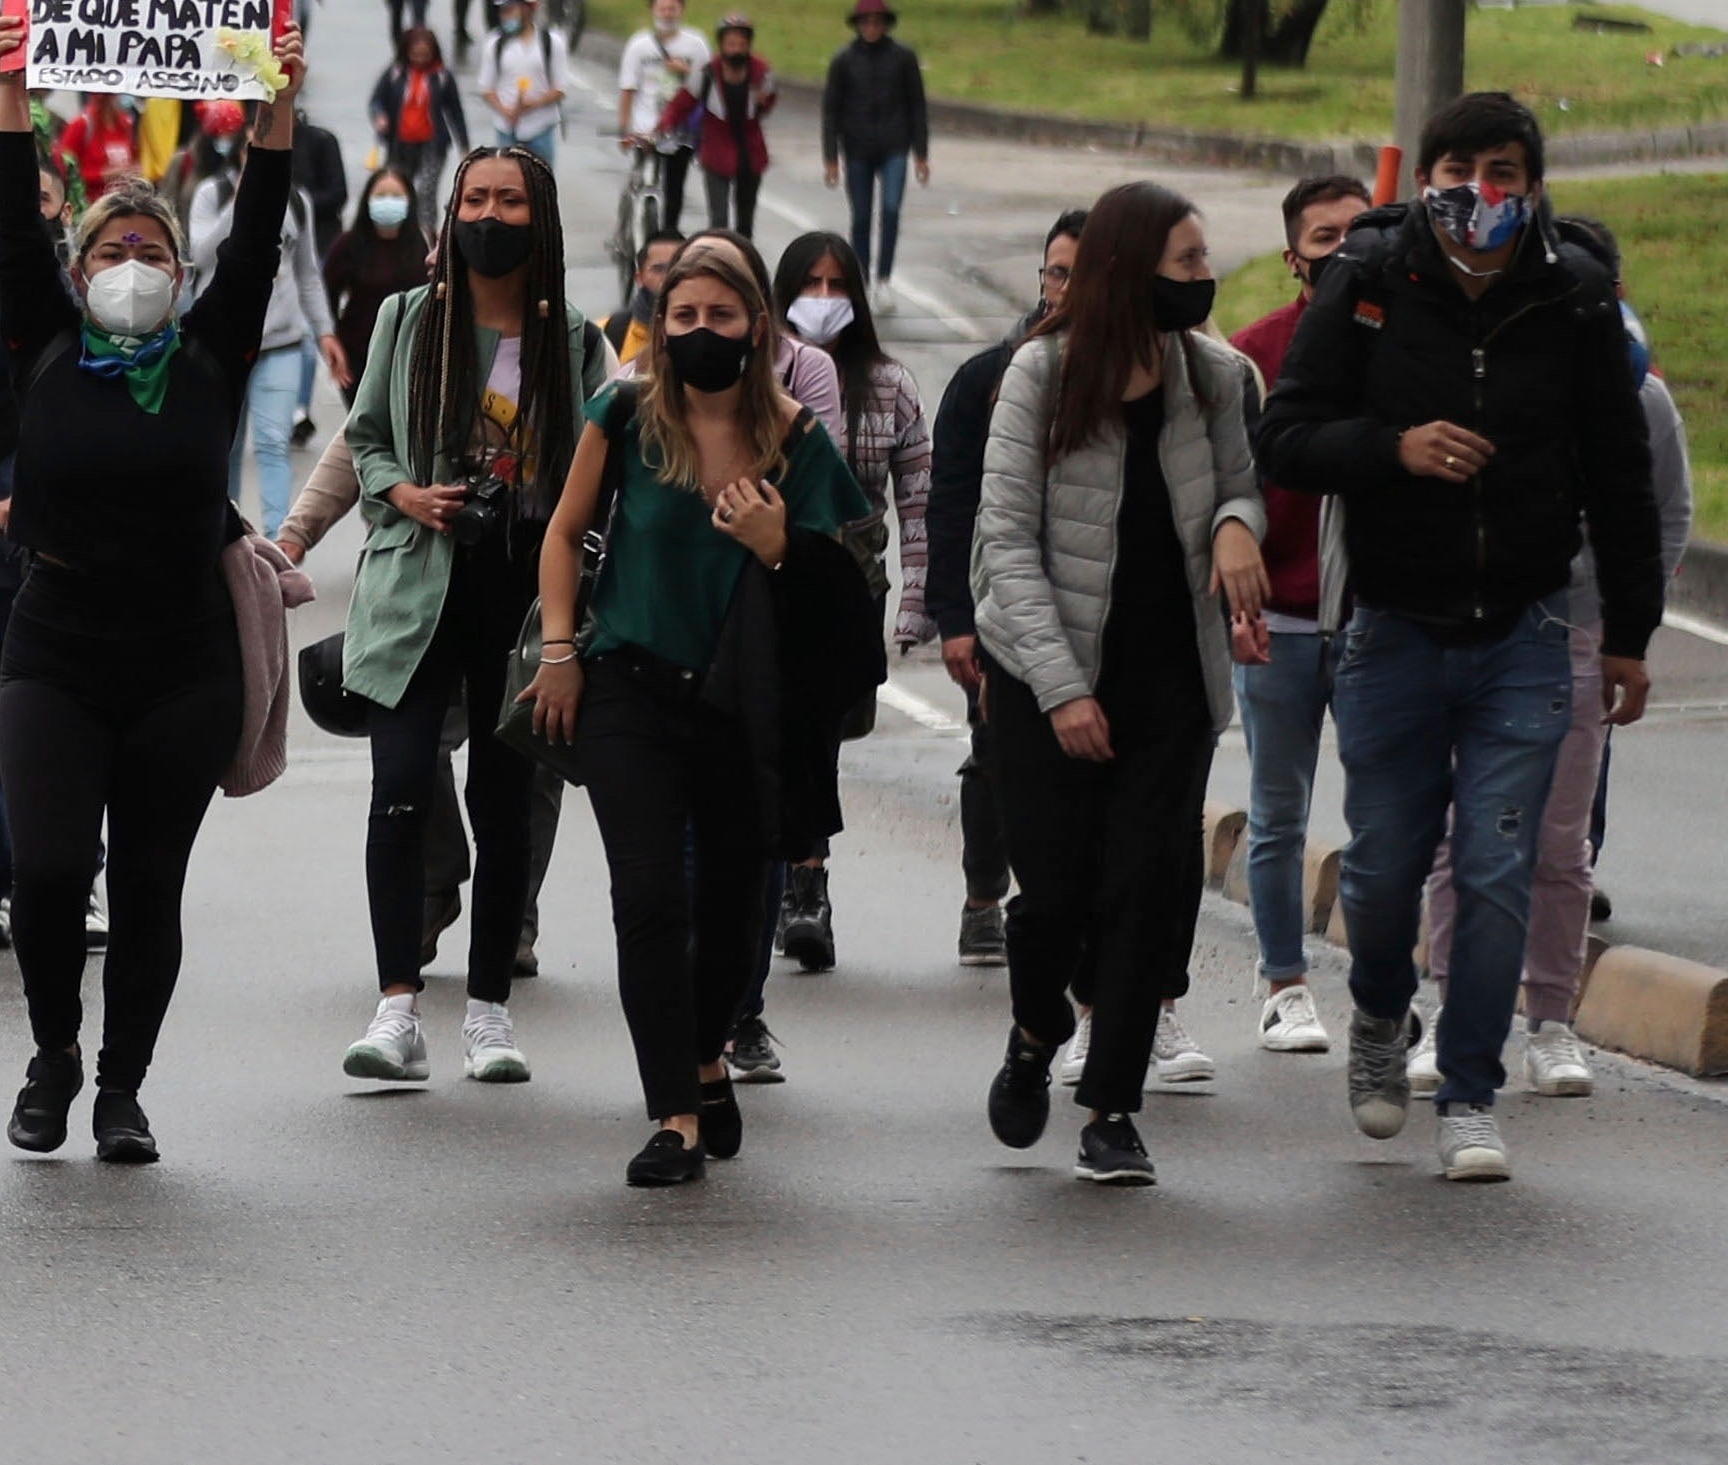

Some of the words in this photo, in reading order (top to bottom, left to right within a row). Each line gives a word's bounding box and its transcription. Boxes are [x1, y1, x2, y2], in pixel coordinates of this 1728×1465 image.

[32, 27, 60, 65] A
[65, 27, 107, 66] MI
[117, 30, 202, 70] PAPÁ
[38, 68, 124, 87] ESTADO
[135, 70, 241, 94] ASESINO
